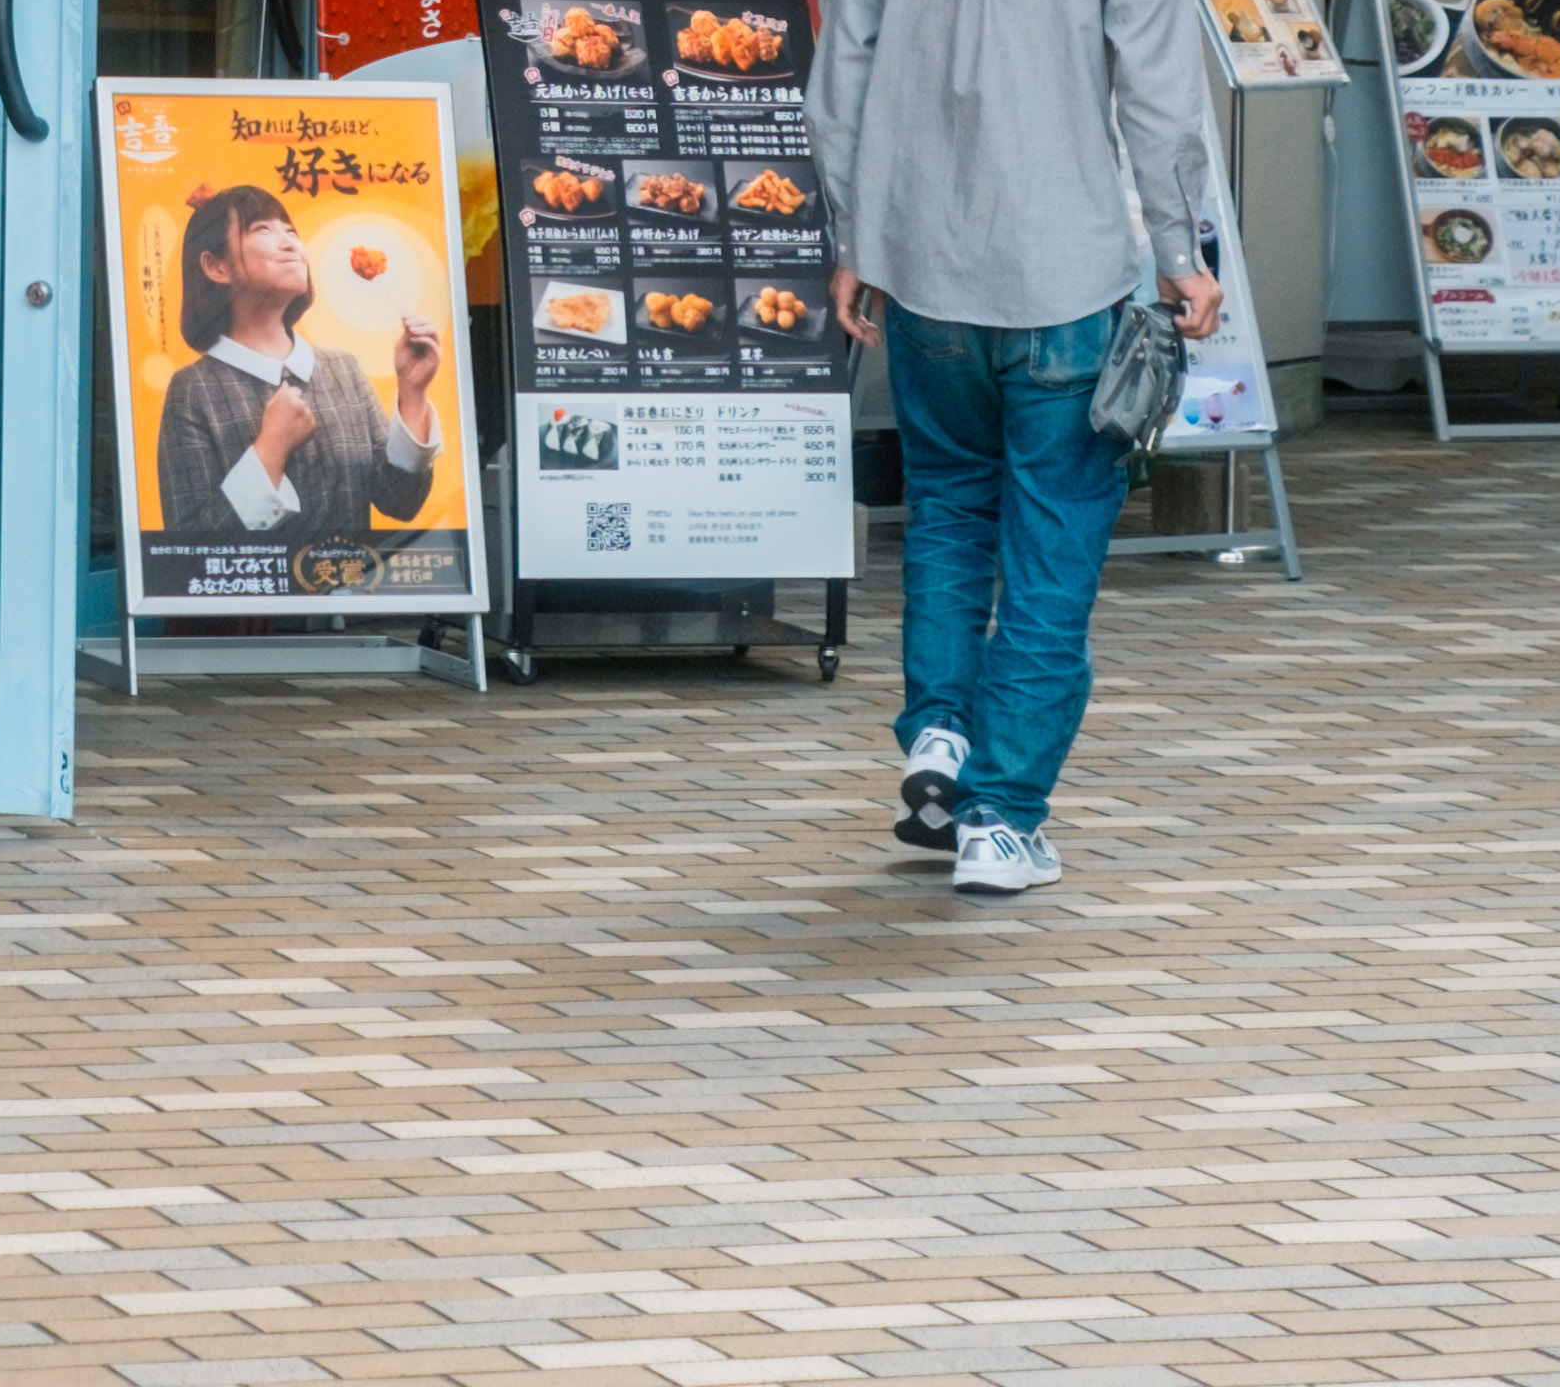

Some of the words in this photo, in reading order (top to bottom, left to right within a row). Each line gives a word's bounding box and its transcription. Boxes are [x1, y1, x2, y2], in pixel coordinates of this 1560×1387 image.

[275, 144, 432, 198] 好きになる
[717, 406, 761, 418] ドリンク
[312, 558, 366, 586] 受賞
